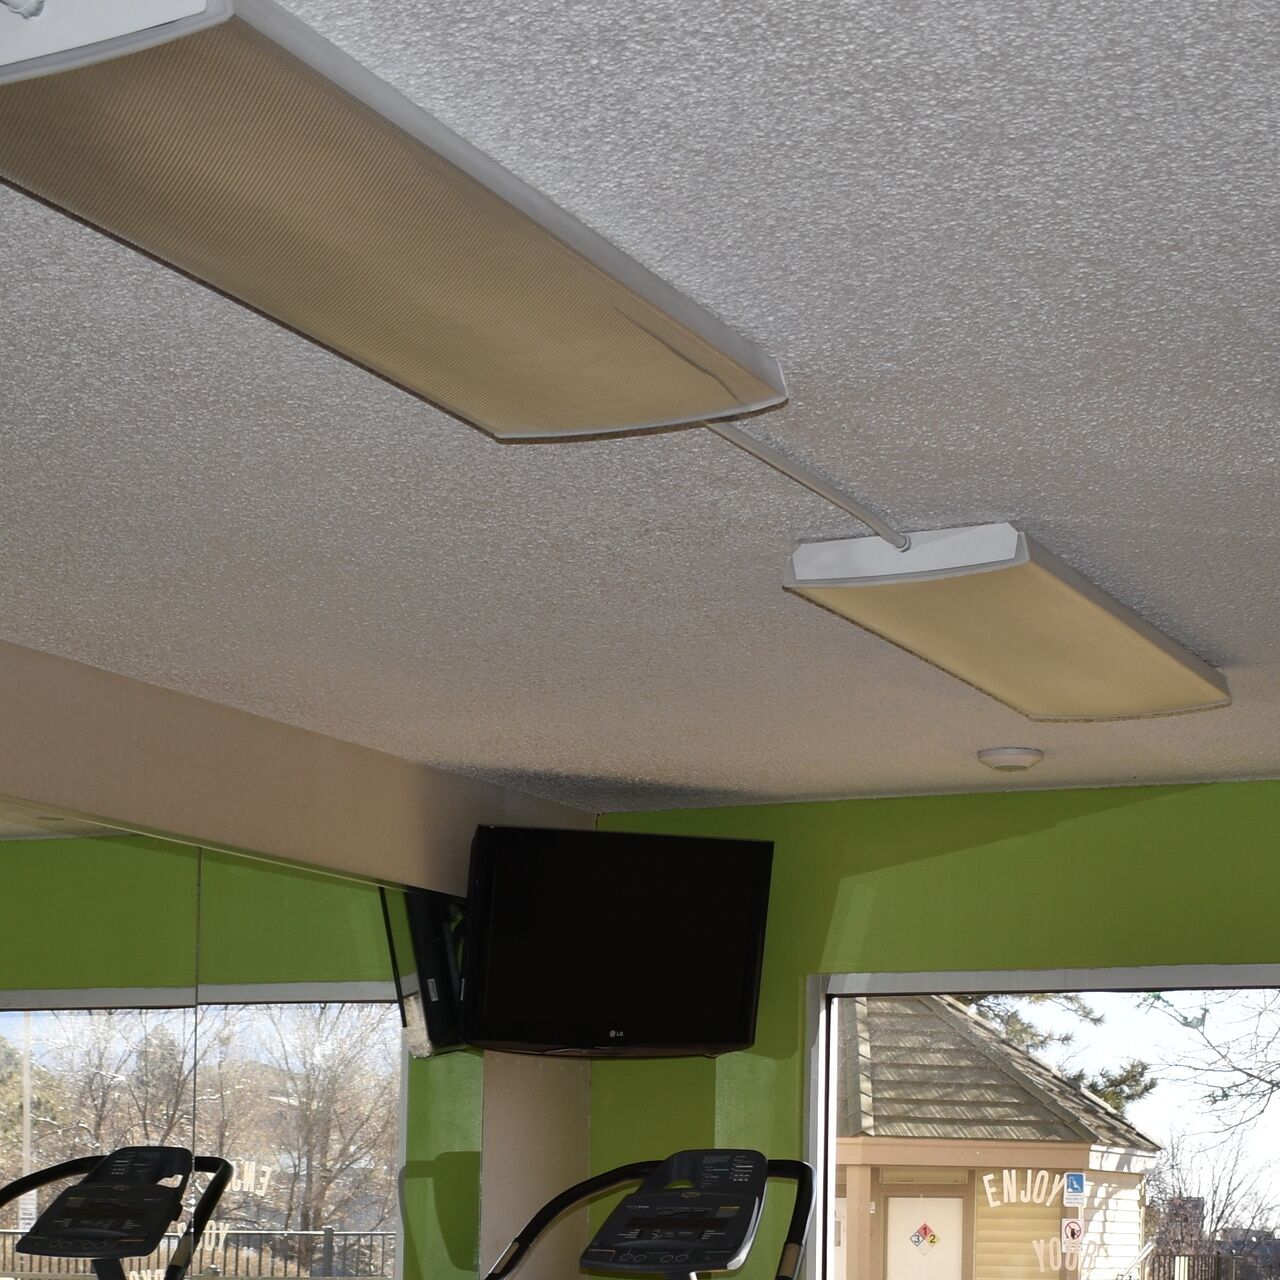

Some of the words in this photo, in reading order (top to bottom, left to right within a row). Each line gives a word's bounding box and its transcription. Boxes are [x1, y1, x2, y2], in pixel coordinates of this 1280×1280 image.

[982, 1169, 1067, 1208] ENJOY
[914, 1234, 920, 1243] 3
[929, 1234, 936, 1243] 2
[923, 1226, 927, 1236] 1
[1031, 1236, 1098, 1274] YOUR
